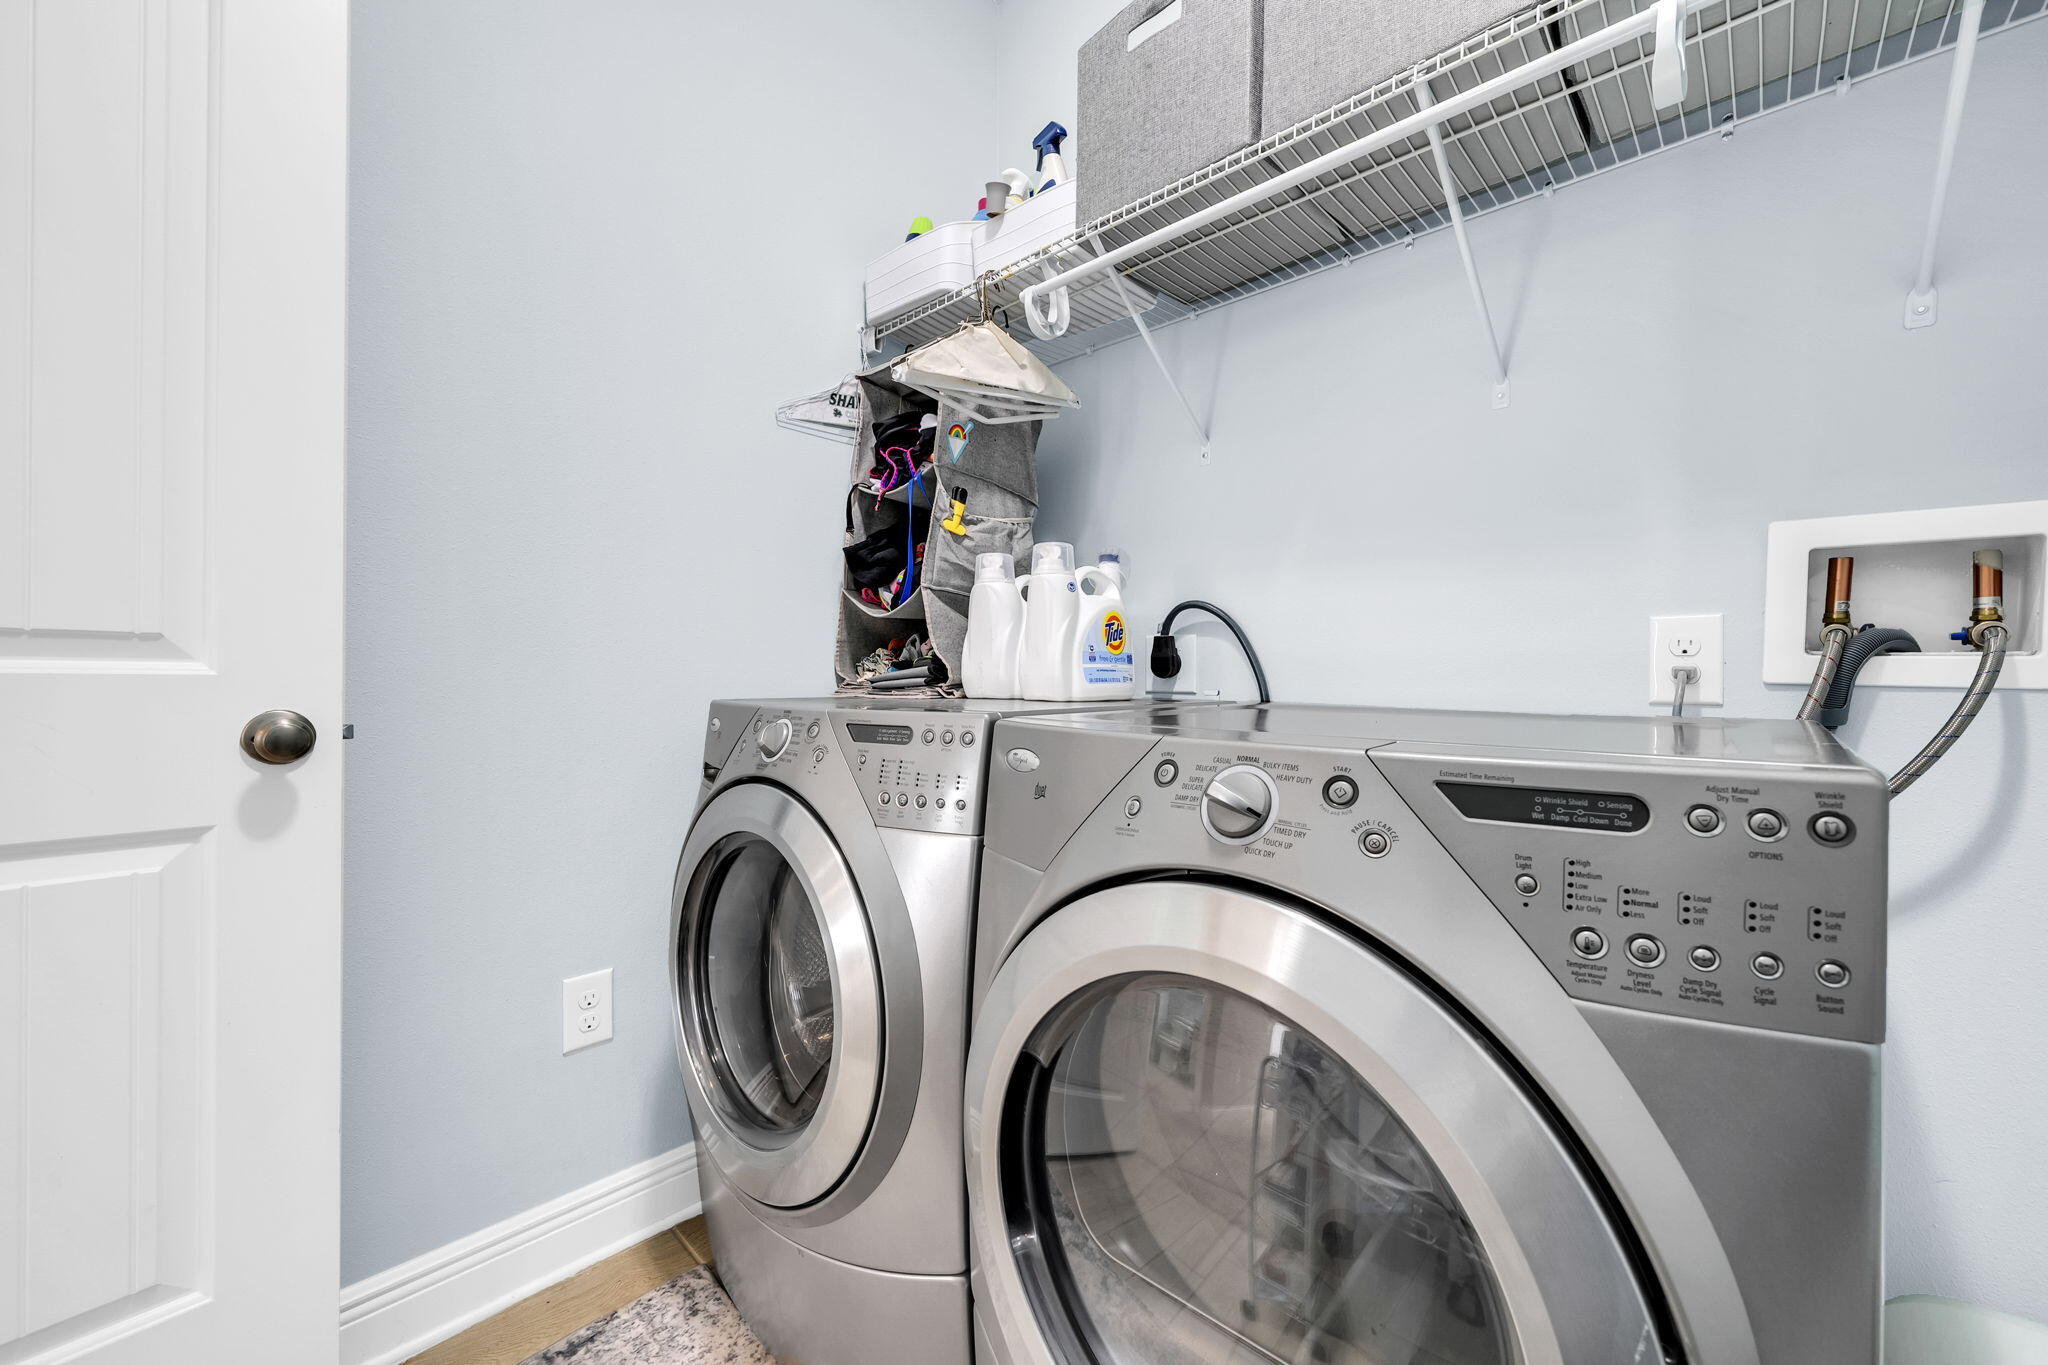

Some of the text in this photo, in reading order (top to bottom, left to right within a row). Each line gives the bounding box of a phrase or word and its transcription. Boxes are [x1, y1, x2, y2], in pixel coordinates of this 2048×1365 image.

[1105, 622, 1124, 646] Tide
[1213, 756, 1232, 764] CASUAL
[1236, 755, 1260, 764] NORMAL
[1195, 764, 1218, 772] DELICATE
[1263, 762, 1299, 772] BULKY ITEMS
[1333, 766, 1352, 774] START
[1296, 776, 1313, 784] DUTY
[1440, 770, 1468, 778] Estimated
[1484, 774, 1515, 783] Remaining
[1182, 783, 1204, 791] DELICATE
[1706, 785, 1760, 795] Adjust Manual
[1716, 794, 1749, 804] Dry Time
[1814, 792, 1846, 800] Wrinkle
[1543, 796, 1588, 806] Wrinkle Shield
[1606, 802, 1633, 811] Sensing
[1551, 814, 1569, 822] Damp
[1614, 819, 1632, 827] Done
[1274, 826, 1292, 836] TIMED
[1351, 820, 1370, 834] PAUSE
[1378, 821, 1399, 842] CANCEL
[1263, 838, 1282, 848] TOUCH
[1244, 847, 1275, 858] QUICK DRY
[1749, 851, 1783, 861] OPTIONS
[1515, 854, 1532, 862] Drum
[1516, 862, 1532, 870] Light
[1576, 859, 1591, 868] High
[1576, 871, 1602, 880] Medium
[1575, 882, 1588, 890] Low
[1632, 888, 1650, 896] More
[1575, 893, 1591, 901] Extra
[1693, 894, 1712, 903] Loud
[1631, 899, 1658, 908] Normal
[1760, 902, 1778, 911] Loud
[1575, 904, 1602, 915] Air Only
[1693, 906, 1708, 914] Soft
[1630, 911, 1645, 919] Less
[1760, 914, 1775, 922] Soft
[1825, 911, 1846, 919] Loud
[1759, 925, 1771, 933] Off
[1825, 922, 1842, 931] Soft
[1824, 934, 1837, 943] Off
[1566, 960, 1608, 972] Temperature
[1627, 969, 1654, 980] Dryness
[1633, 980, 1651, 988] Level
[1683, 977, 1717, 990] Damp Dry
[1680, 985, 1722, 997] Cycle Signal
[1754, 986, 1775, 996] Cycle
[1754, 996, 1777, 1006] Signal
